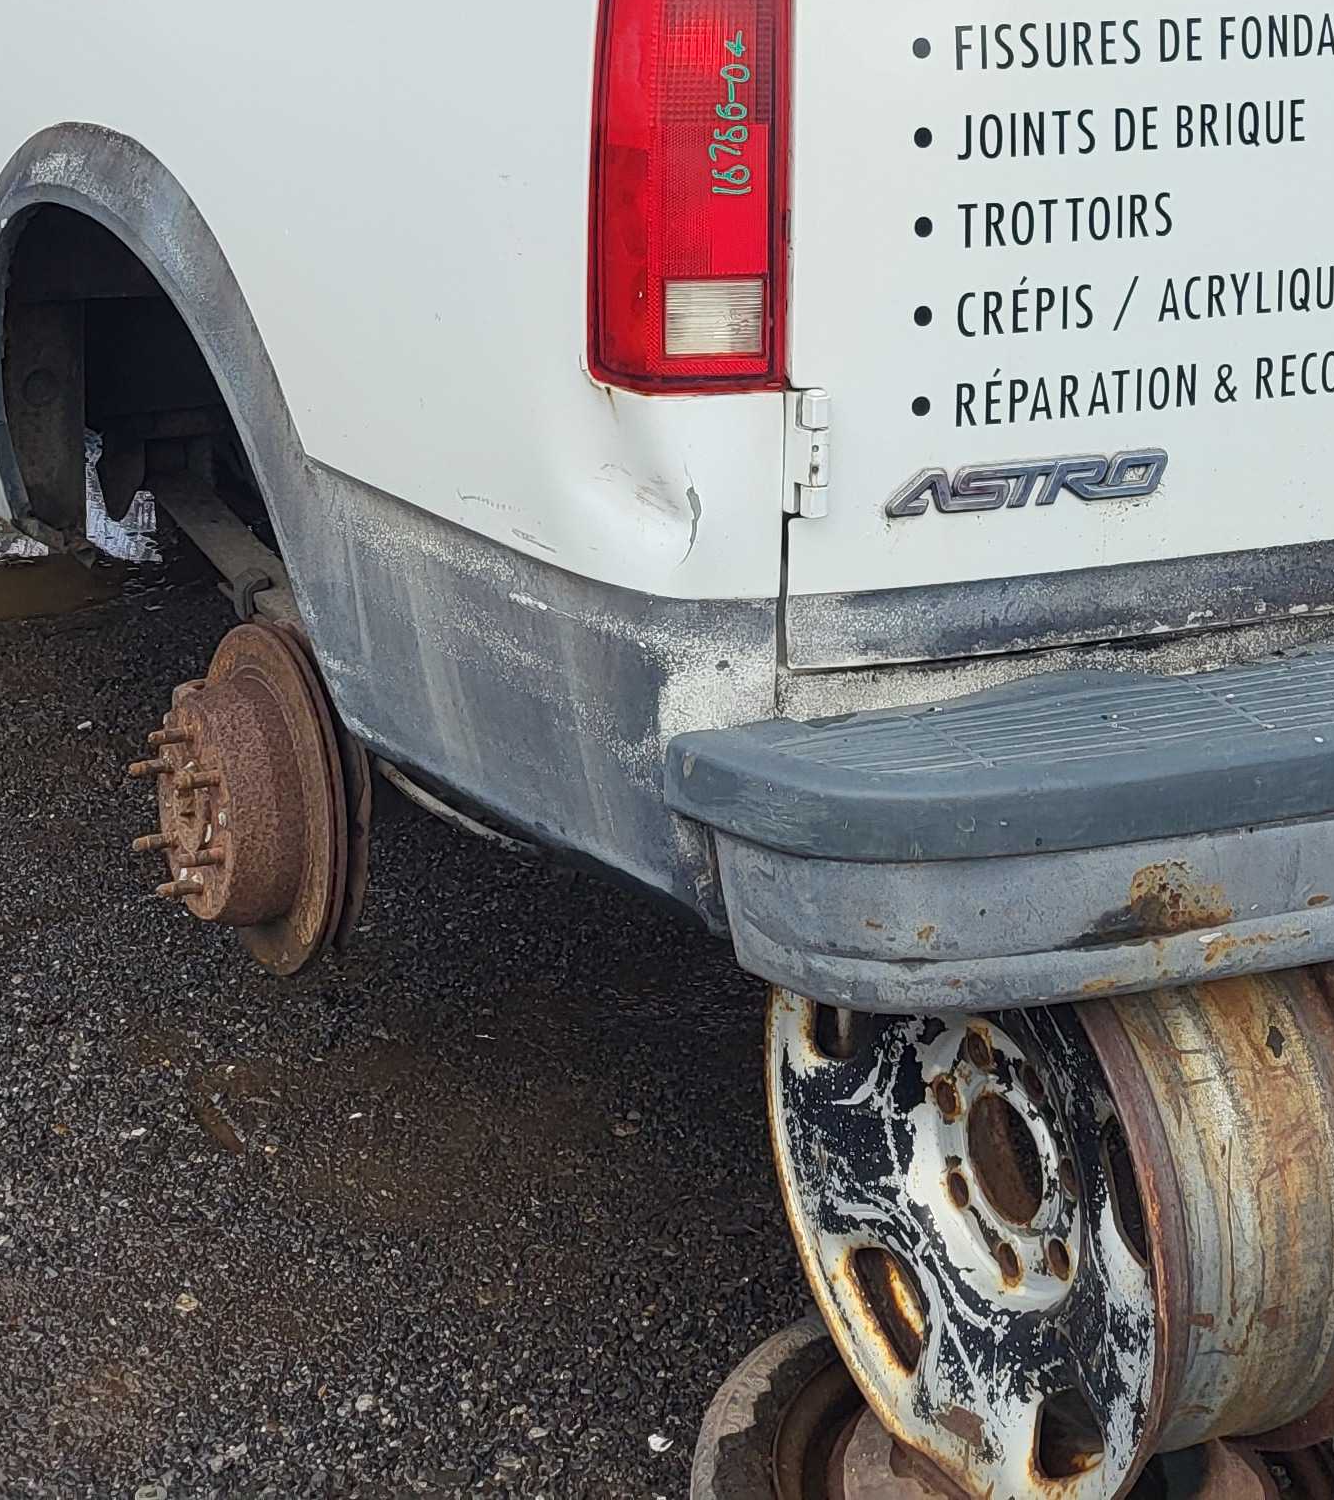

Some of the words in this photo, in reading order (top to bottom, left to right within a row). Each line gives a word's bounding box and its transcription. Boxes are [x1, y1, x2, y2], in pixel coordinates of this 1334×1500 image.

[954, 19, 1142, 71] FISSURES
[1159, 17, 1203, 64] DE
[956, 108, 1096, 161] JOINTS
[1114, 106, 1158, 153] DE
[1176, 99, 1307, 149] BRIQUE
[957, 192, 1175, 249] TROTTOIRS
[956, 276, 1095, 338] CRÉPIS
[1113, 276, 1140, 333] /
[956, 363, 1198, 428] RÉPARATION
[1213, 363, 1238, 405] &
[885, 448, 1169, 519] ASTRO
